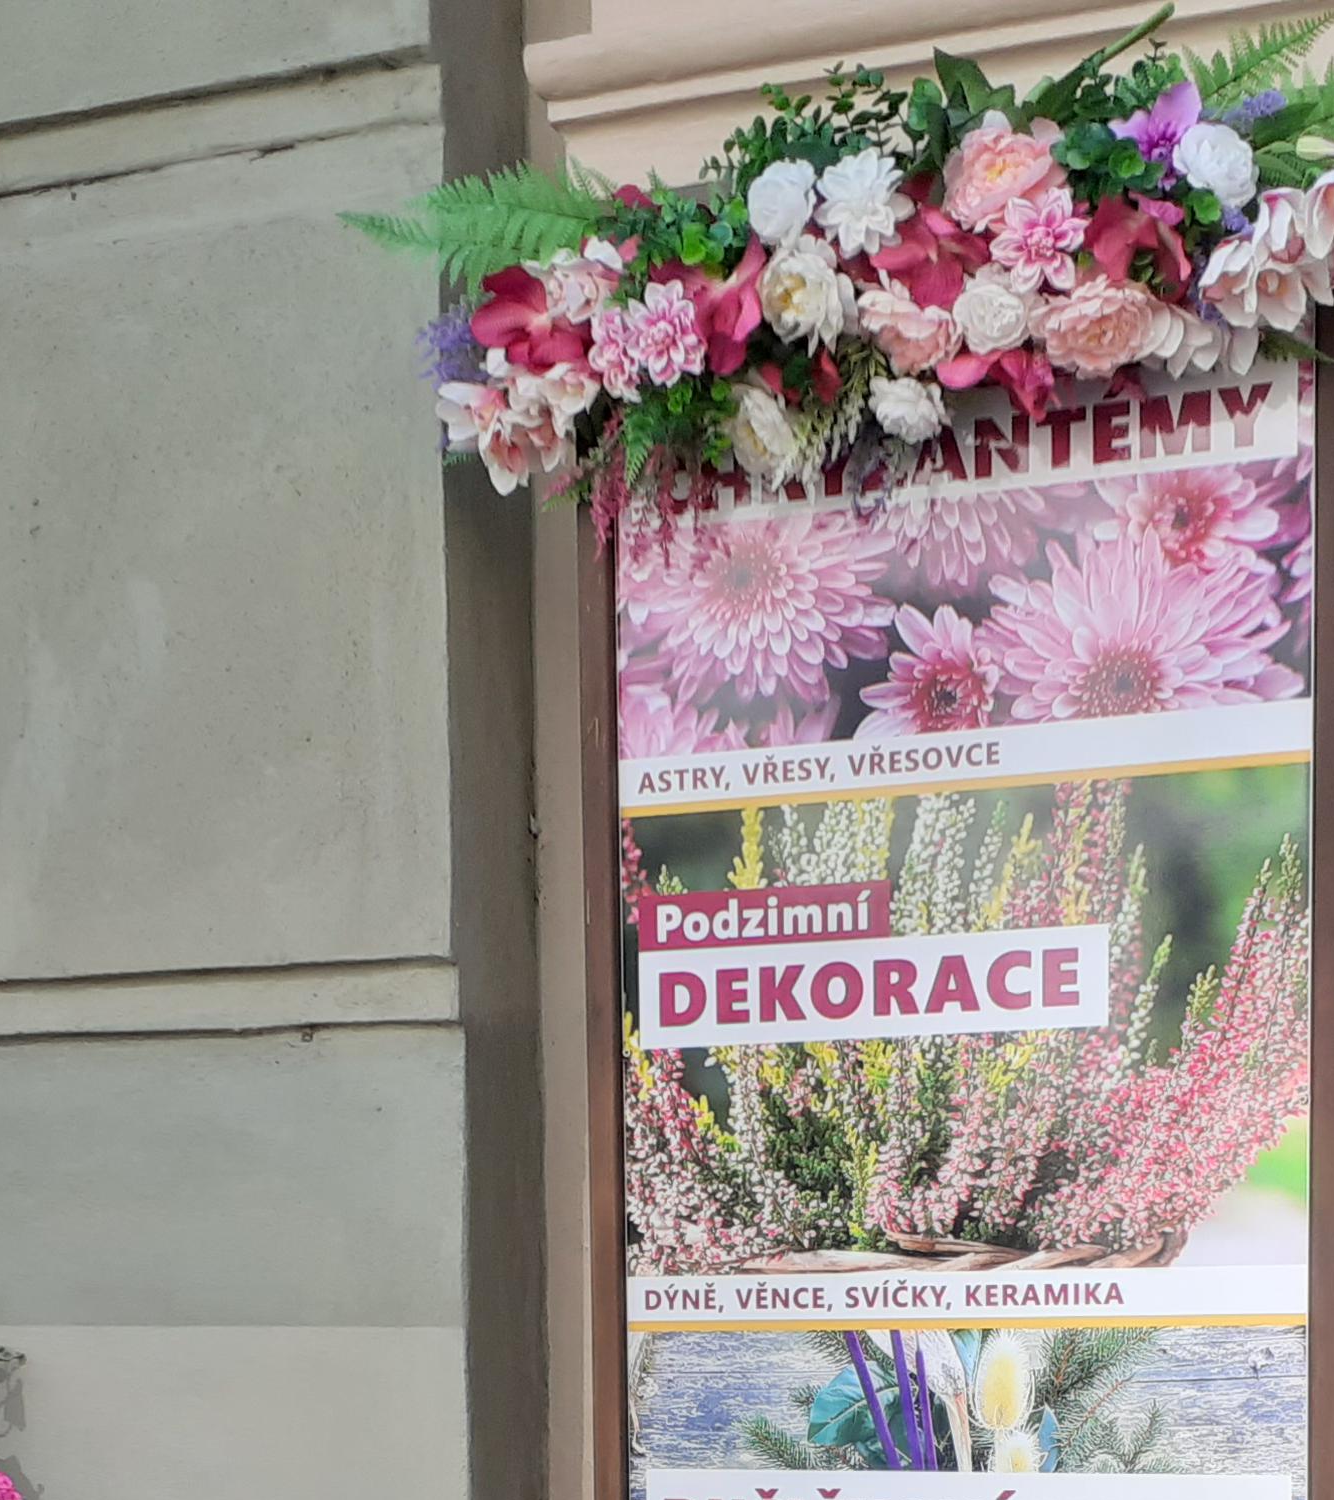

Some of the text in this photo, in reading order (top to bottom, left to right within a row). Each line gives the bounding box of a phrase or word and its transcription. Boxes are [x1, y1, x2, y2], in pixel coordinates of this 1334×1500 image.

[638, 742, 1001, 794] ASTRY, VŘESY, VŘESOVCE
[656, 889, 871, 943] Podzimní
[658, 947, 1080, 1028] DEKORACE
[644, 1280, 1124, 1314] DÝNĚ, VĚNCE, SVÍČKY, KERAMIKA
